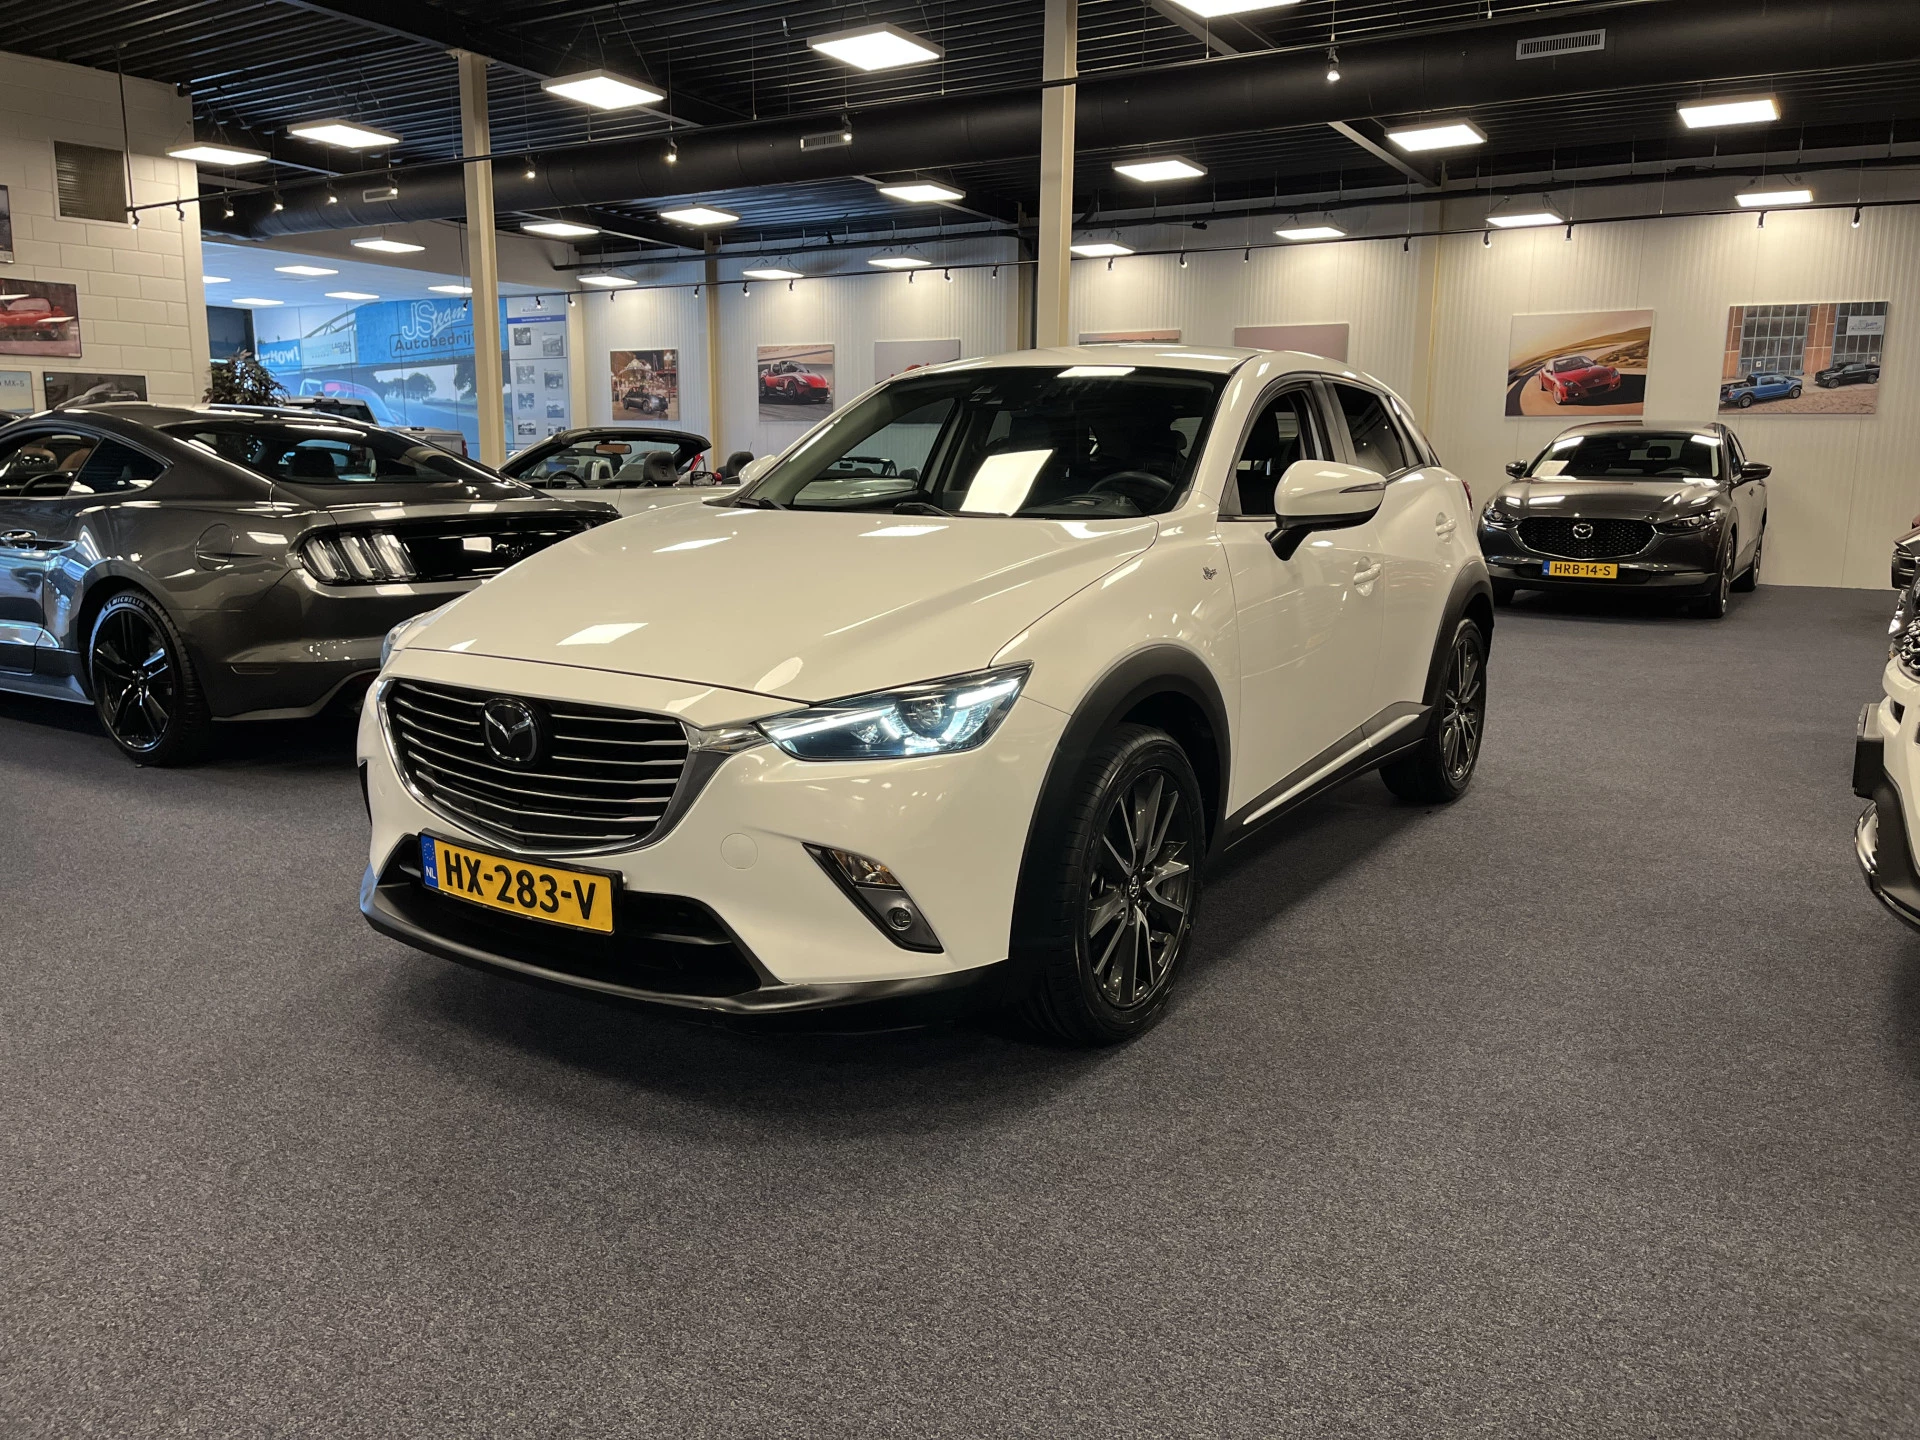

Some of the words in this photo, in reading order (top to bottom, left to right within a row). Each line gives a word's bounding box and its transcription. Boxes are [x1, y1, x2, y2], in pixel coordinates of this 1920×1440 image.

[4, 379, 25, 388] MX-5
[1554, 563, 1611, 576] HRB-14-S
[112, 596, 145, 607] MICHELIN
[425, 865, 437, 880] NL
[444, 849, 596, 920] HX-283-V
